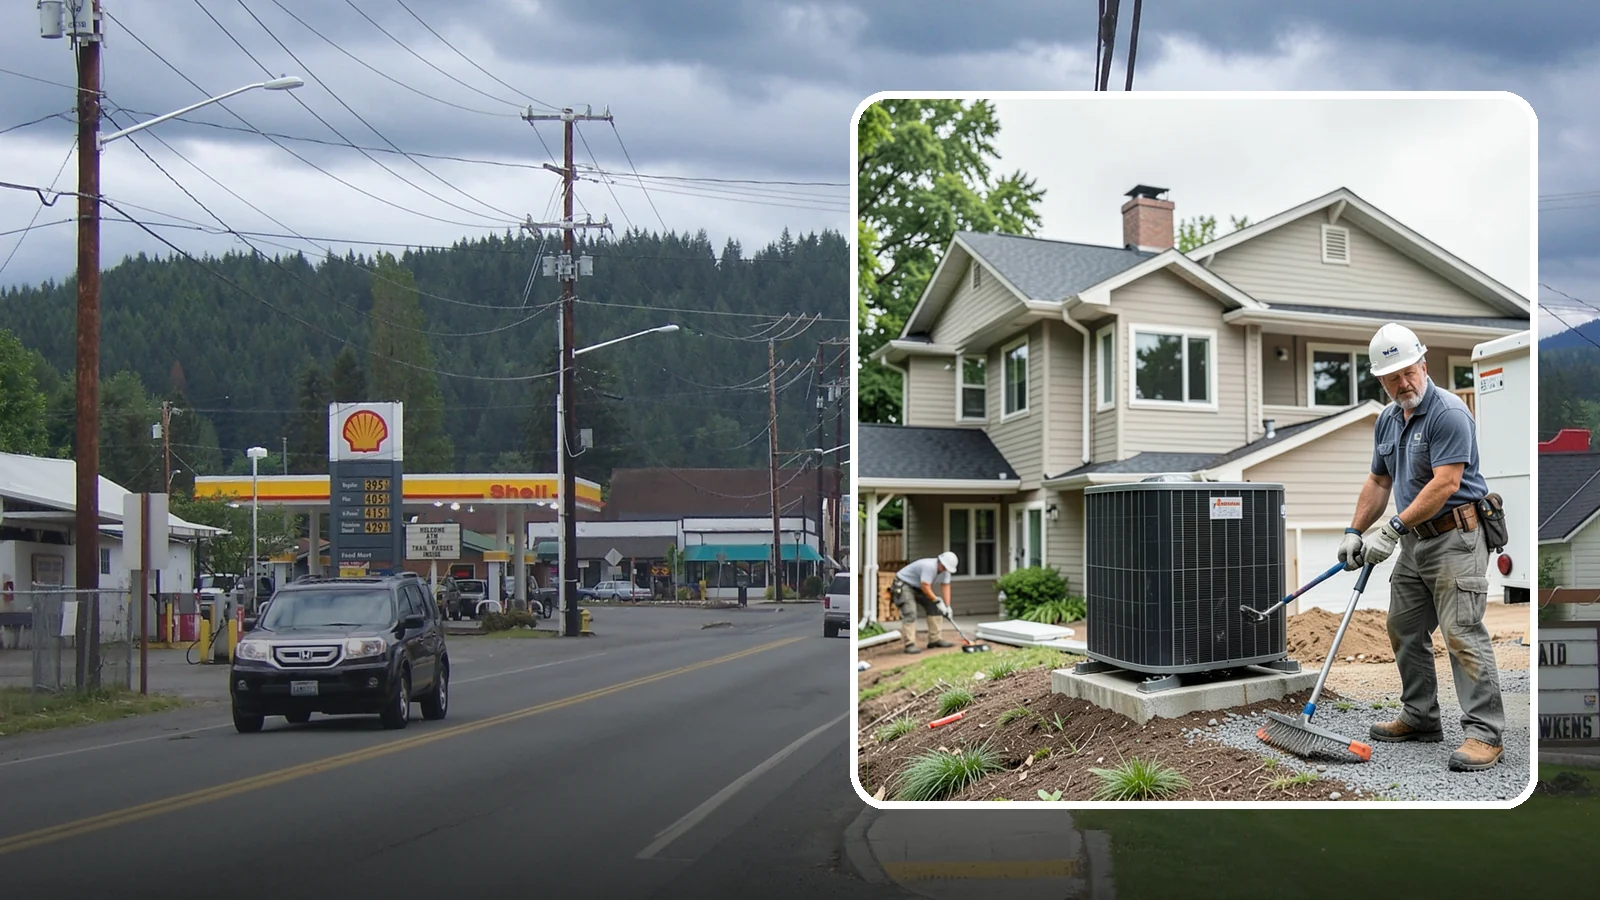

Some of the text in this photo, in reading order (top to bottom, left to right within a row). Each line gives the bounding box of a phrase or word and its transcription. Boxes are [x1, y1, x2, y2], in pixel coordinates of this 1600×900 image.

[366, 480, 383, 490] 395
[490, 484, 547, 499] Shell
[366, 494, 383, 504] 405
[366, 508, 383, 518] 415
[366, 522, 383, 532] 429
